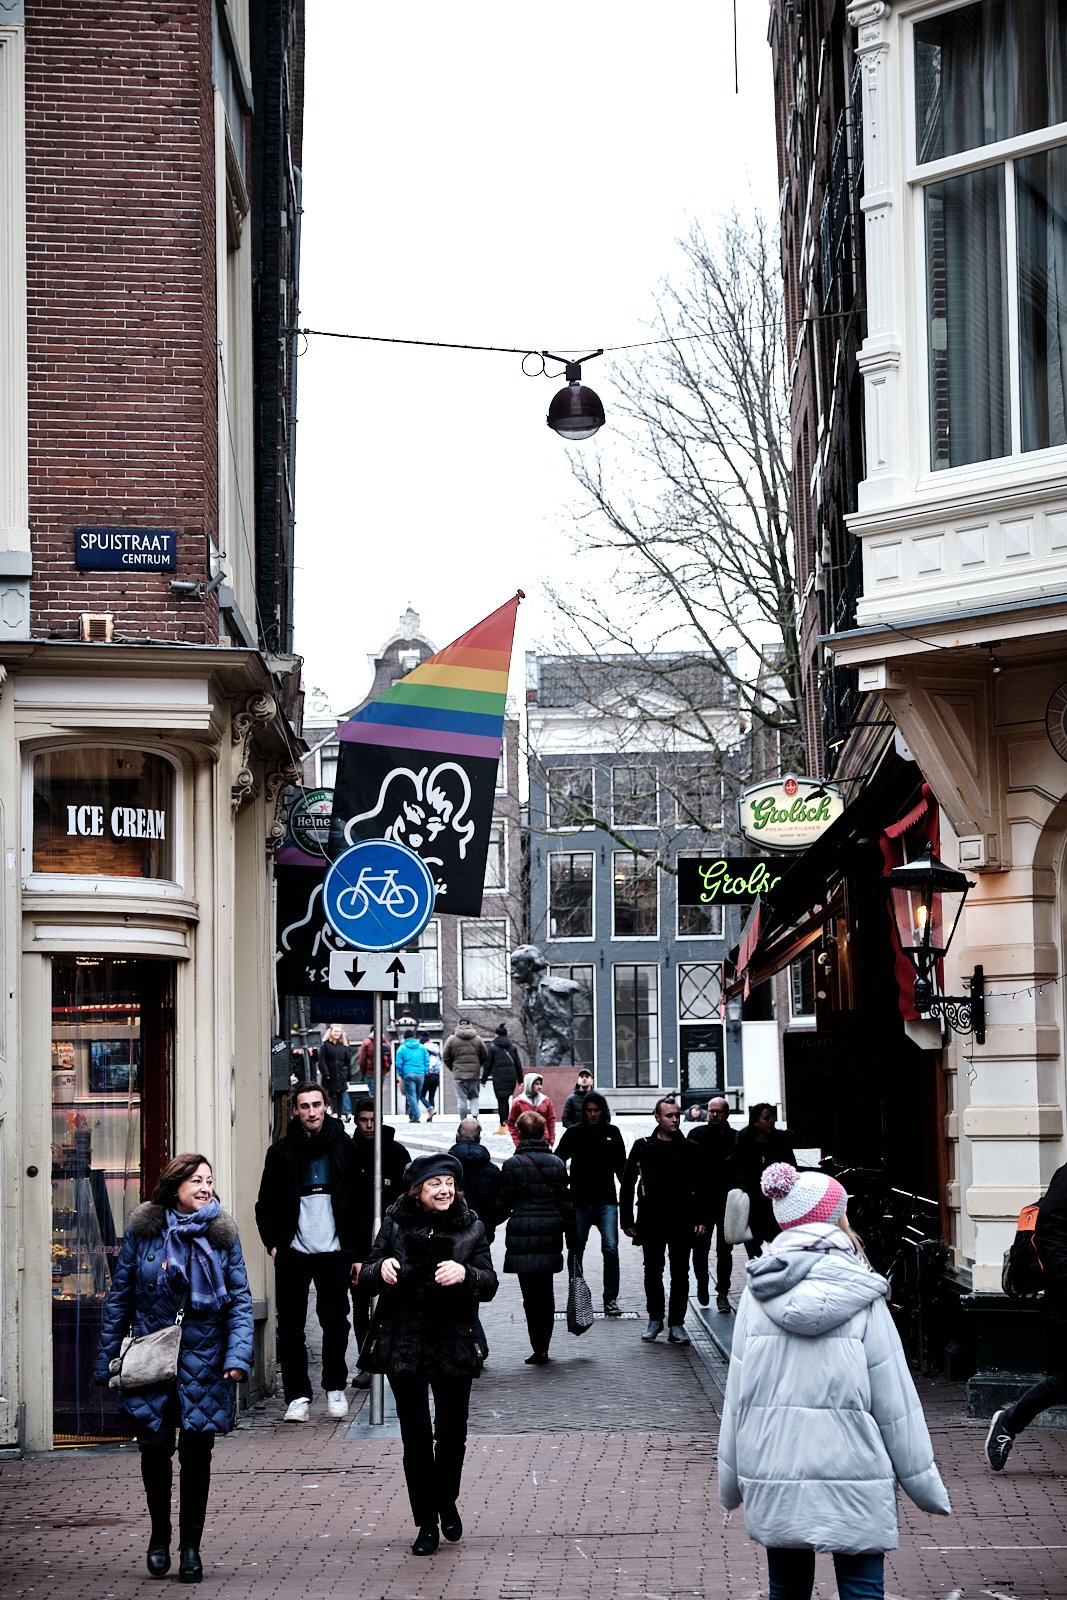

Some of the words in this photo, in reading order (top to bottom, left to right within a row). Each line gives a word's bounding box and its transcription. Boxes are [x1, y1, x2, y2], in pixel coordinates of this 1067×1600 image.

[80, 533, 170, 551] SPUISTRAAT
[122, 553, 170, 565] CENTRUM
[66, 805, 104, 836] ICE
[111, 806, 165, 840] CREAM
[750, 797, 831, 829] Grolsch
